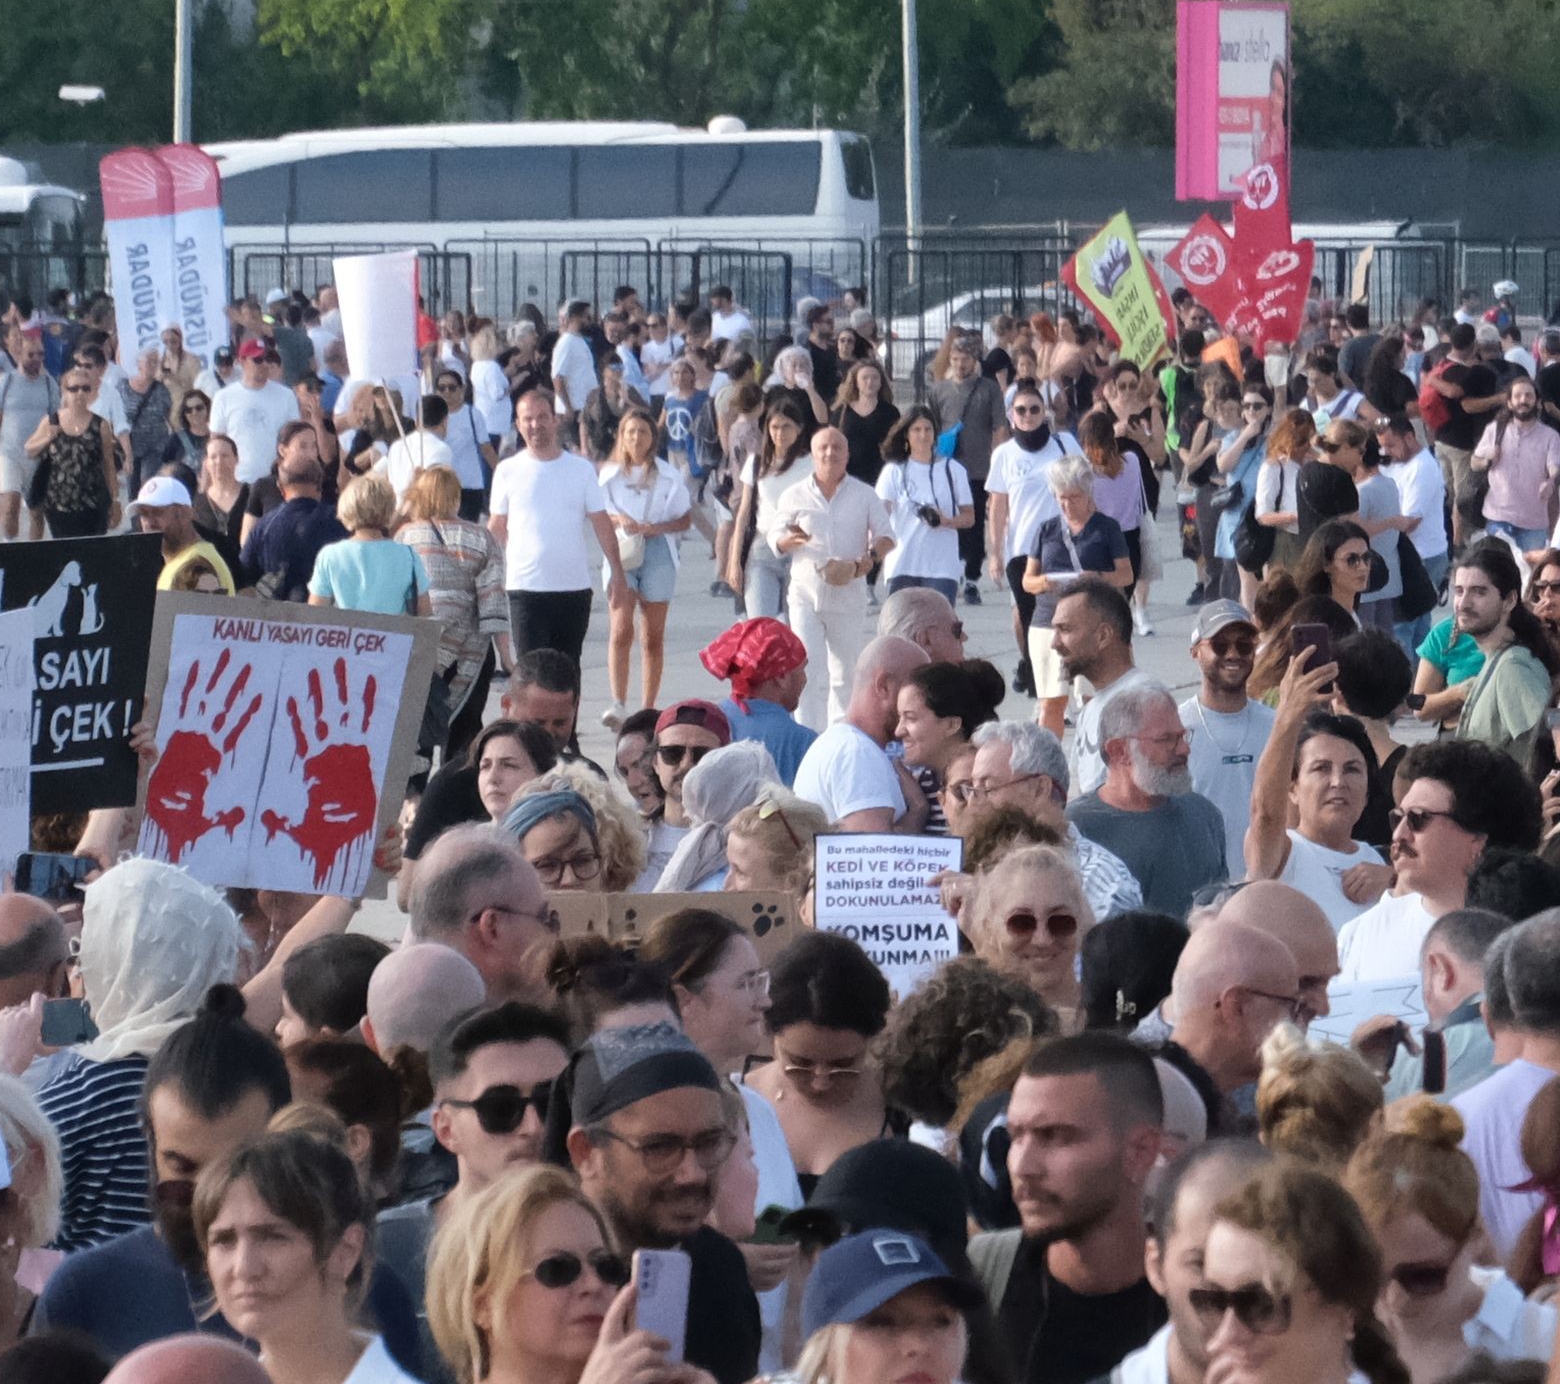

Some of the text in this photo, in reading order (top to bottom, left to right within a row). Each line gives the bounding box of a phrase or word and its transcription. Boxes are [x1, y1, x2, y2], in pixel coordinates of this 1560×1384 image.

[213, 619, 264, 642] KANLI
[316, 627, 352, 649] GERİ
[354, 633, 387, 656] ÇEK
[51, 706, 116, 754] ÇEK
[826, 845, 952, 858] Bu mahalledeki hiçbir
[826, 858, 863, 874] KEDİ
[867, 860, 889, 873] VE
[826, 877, 883, 892] sahipsiz
